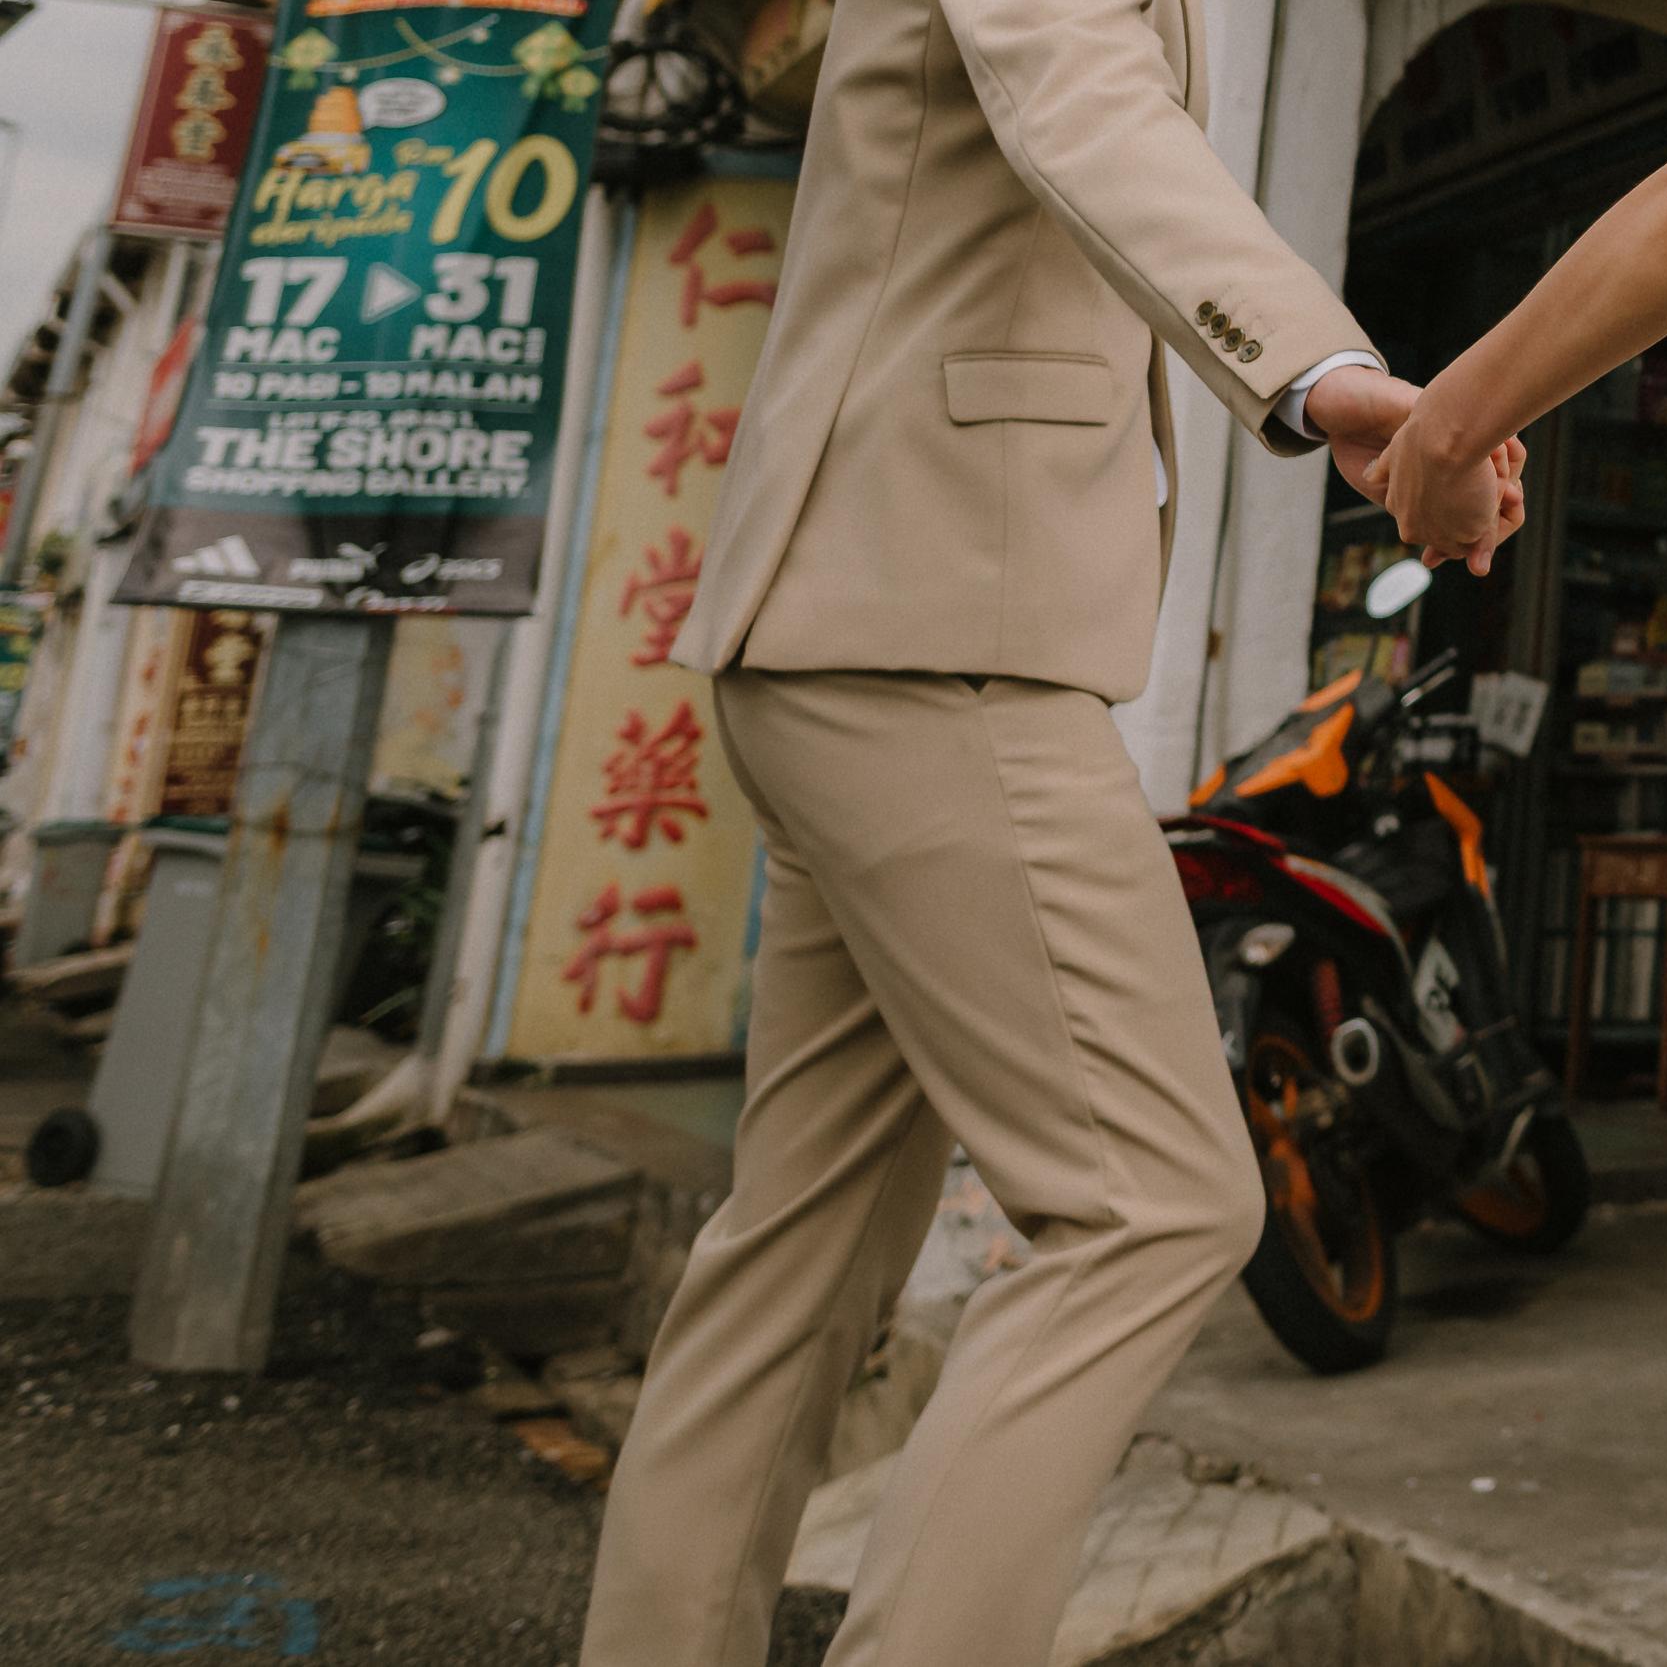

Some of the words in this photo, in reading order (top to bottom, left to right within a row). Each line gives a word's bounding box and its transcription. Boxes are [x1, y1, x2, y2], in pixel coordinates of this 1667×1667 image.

[253, 167, 420, 226] Harga
[430, 133, 578, 245] 10
[240, 255, 349, 329] 17
[423, 251, 540, 329] 31
[222, 325, 342, 364] MAC
[404, 370, 543, 405] MALAM
[197, 425, 324, 470] THE
[326, 426, 534, 472] SHORE
